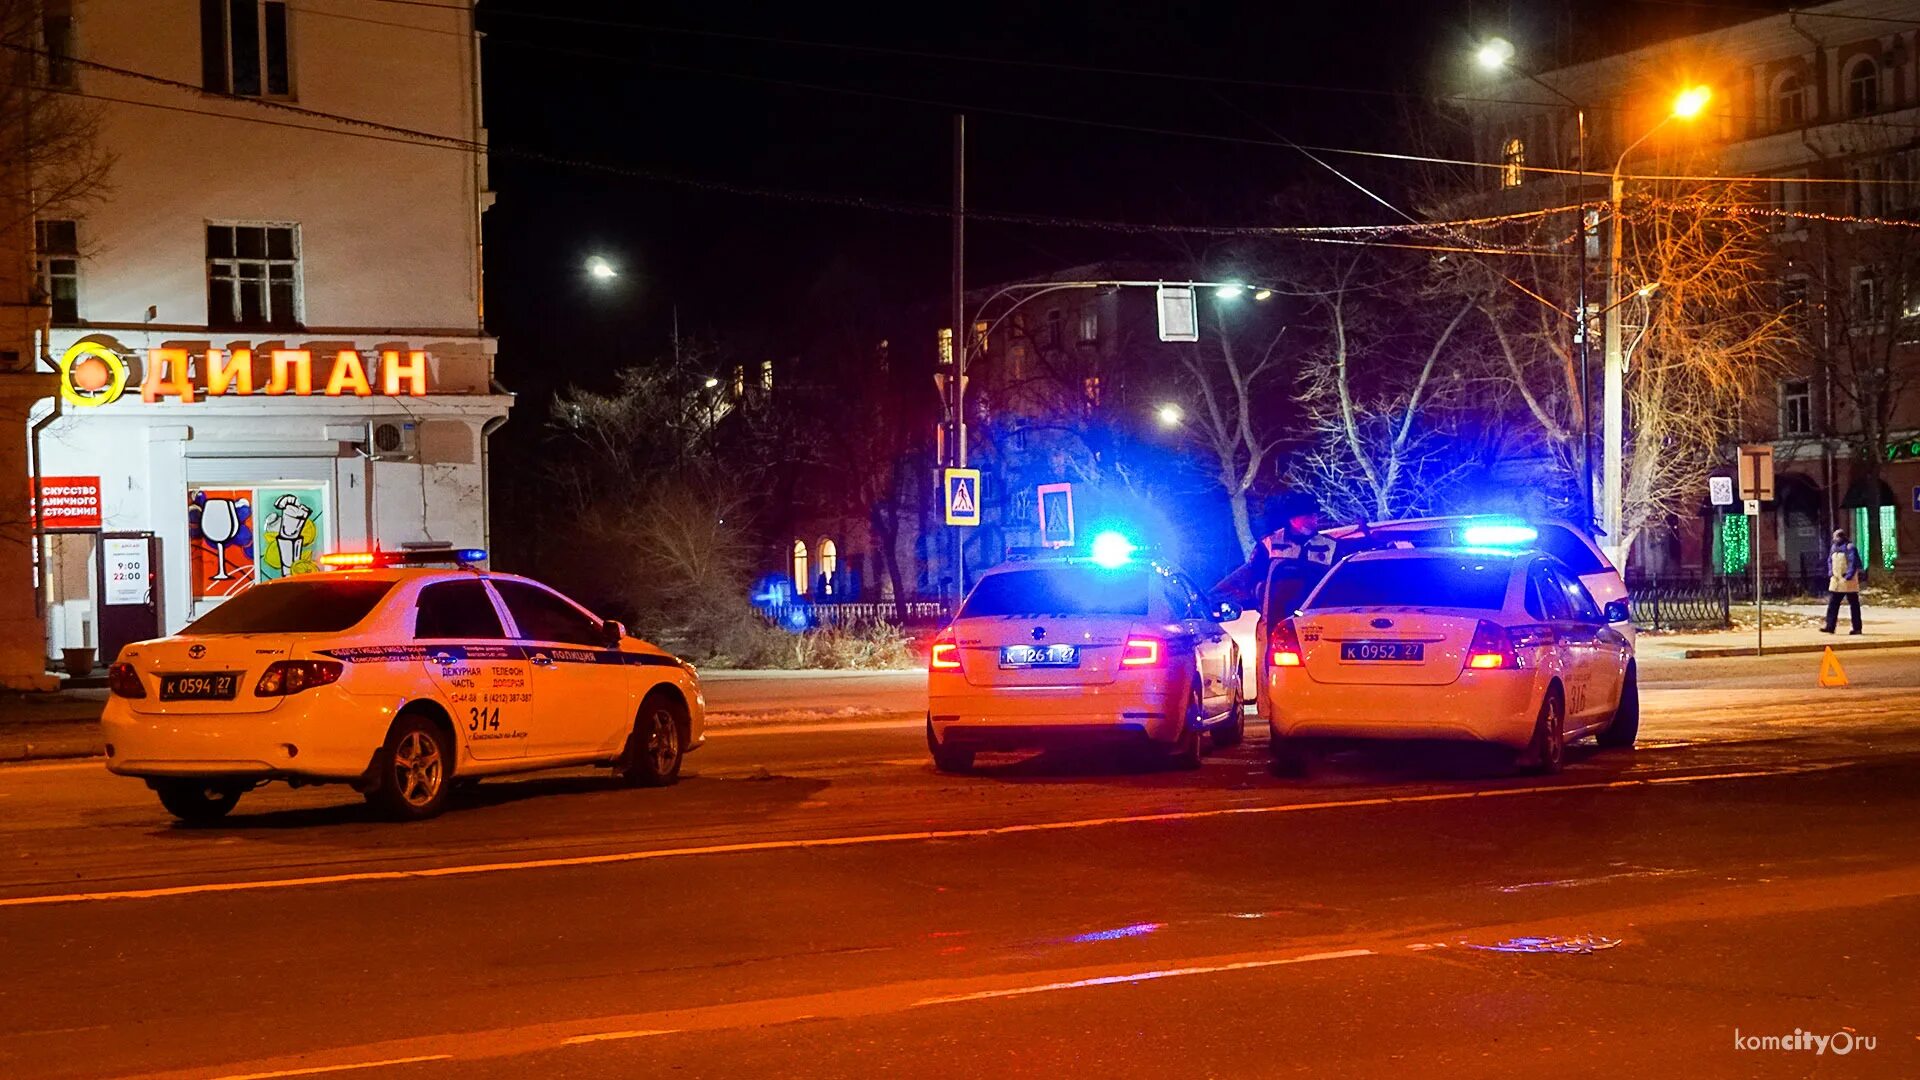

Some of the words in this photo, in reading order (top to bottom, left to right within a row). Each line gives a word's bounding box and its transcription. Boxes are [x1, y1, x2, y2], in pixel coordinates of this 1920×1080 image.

[141, 349, 427, 403] ДИЛАН
[42, 487, 97, 496] СКУССТВО
[117, 562, 140, 570] 9:00
[113, 572, 141, 580] 22:00
[551, 650, 597, 662] ПОЛИЦИЯ
[1361, 645, 1396, 659] 0952
[1405, 645, 1419, 655] 27
[442, 667, 481, 677] ДЕЖУРНАЯ
[492, 667, 523, 675] ТЕЛЕФОН
[179, 678, 211, 694] 0594
[217, 677, 231, 689] 27
[452, 680, 475, 688] ЧАСТЬ
[469, 707, 499, 731] 314
